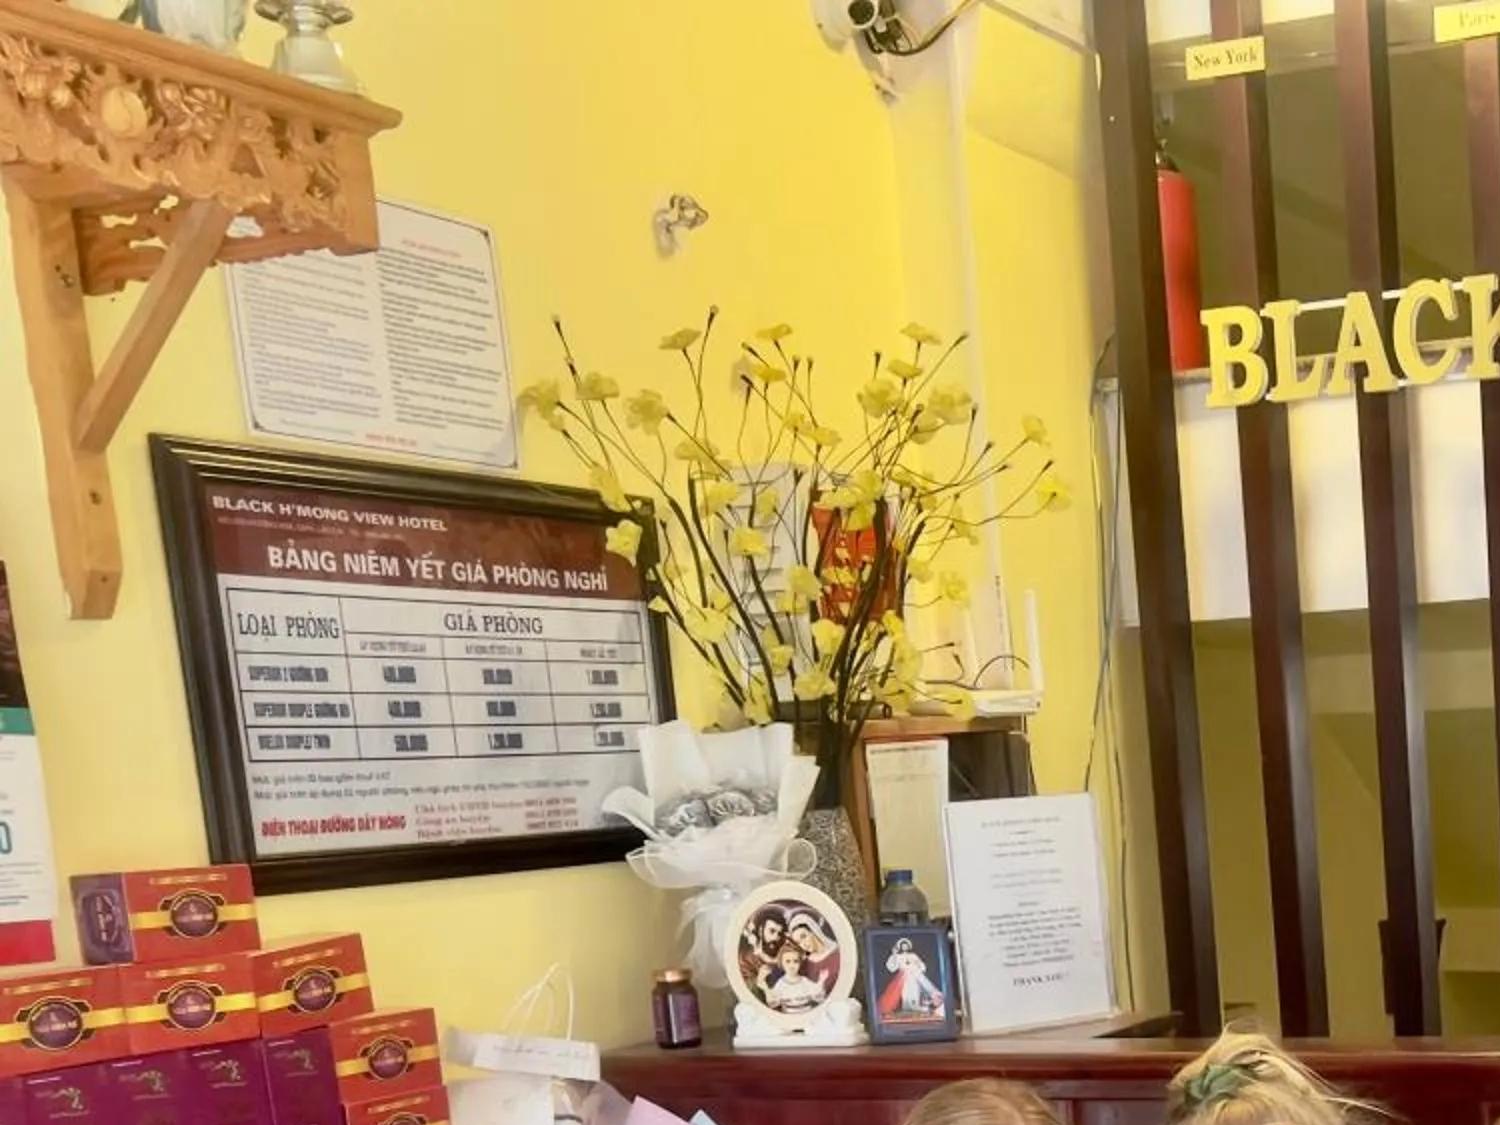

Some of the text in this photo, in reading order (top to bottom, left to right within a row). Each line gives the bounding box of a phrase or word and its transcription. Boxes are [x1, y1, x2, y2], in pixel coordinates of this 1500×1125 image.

[1193, 47, 1258, 69] New York
[212, 496, 274, 514] BLACK
[279, 503, 349, 523] H'MONG
[353, 511, 394, 526] VIEW
[397, 515, 448, 532] HOTEL
[267, 539, 337, 572] BẢNG
[405, 551, 446, 580] YẾT
[451, 558, 488, 584] GIÁ
[492, 561, 560, 590] PHÒNG
[237, 611, 340, 642] LOẠI PHÒNG
[444, 609, 544, 634] GIÁ PHÒNG
